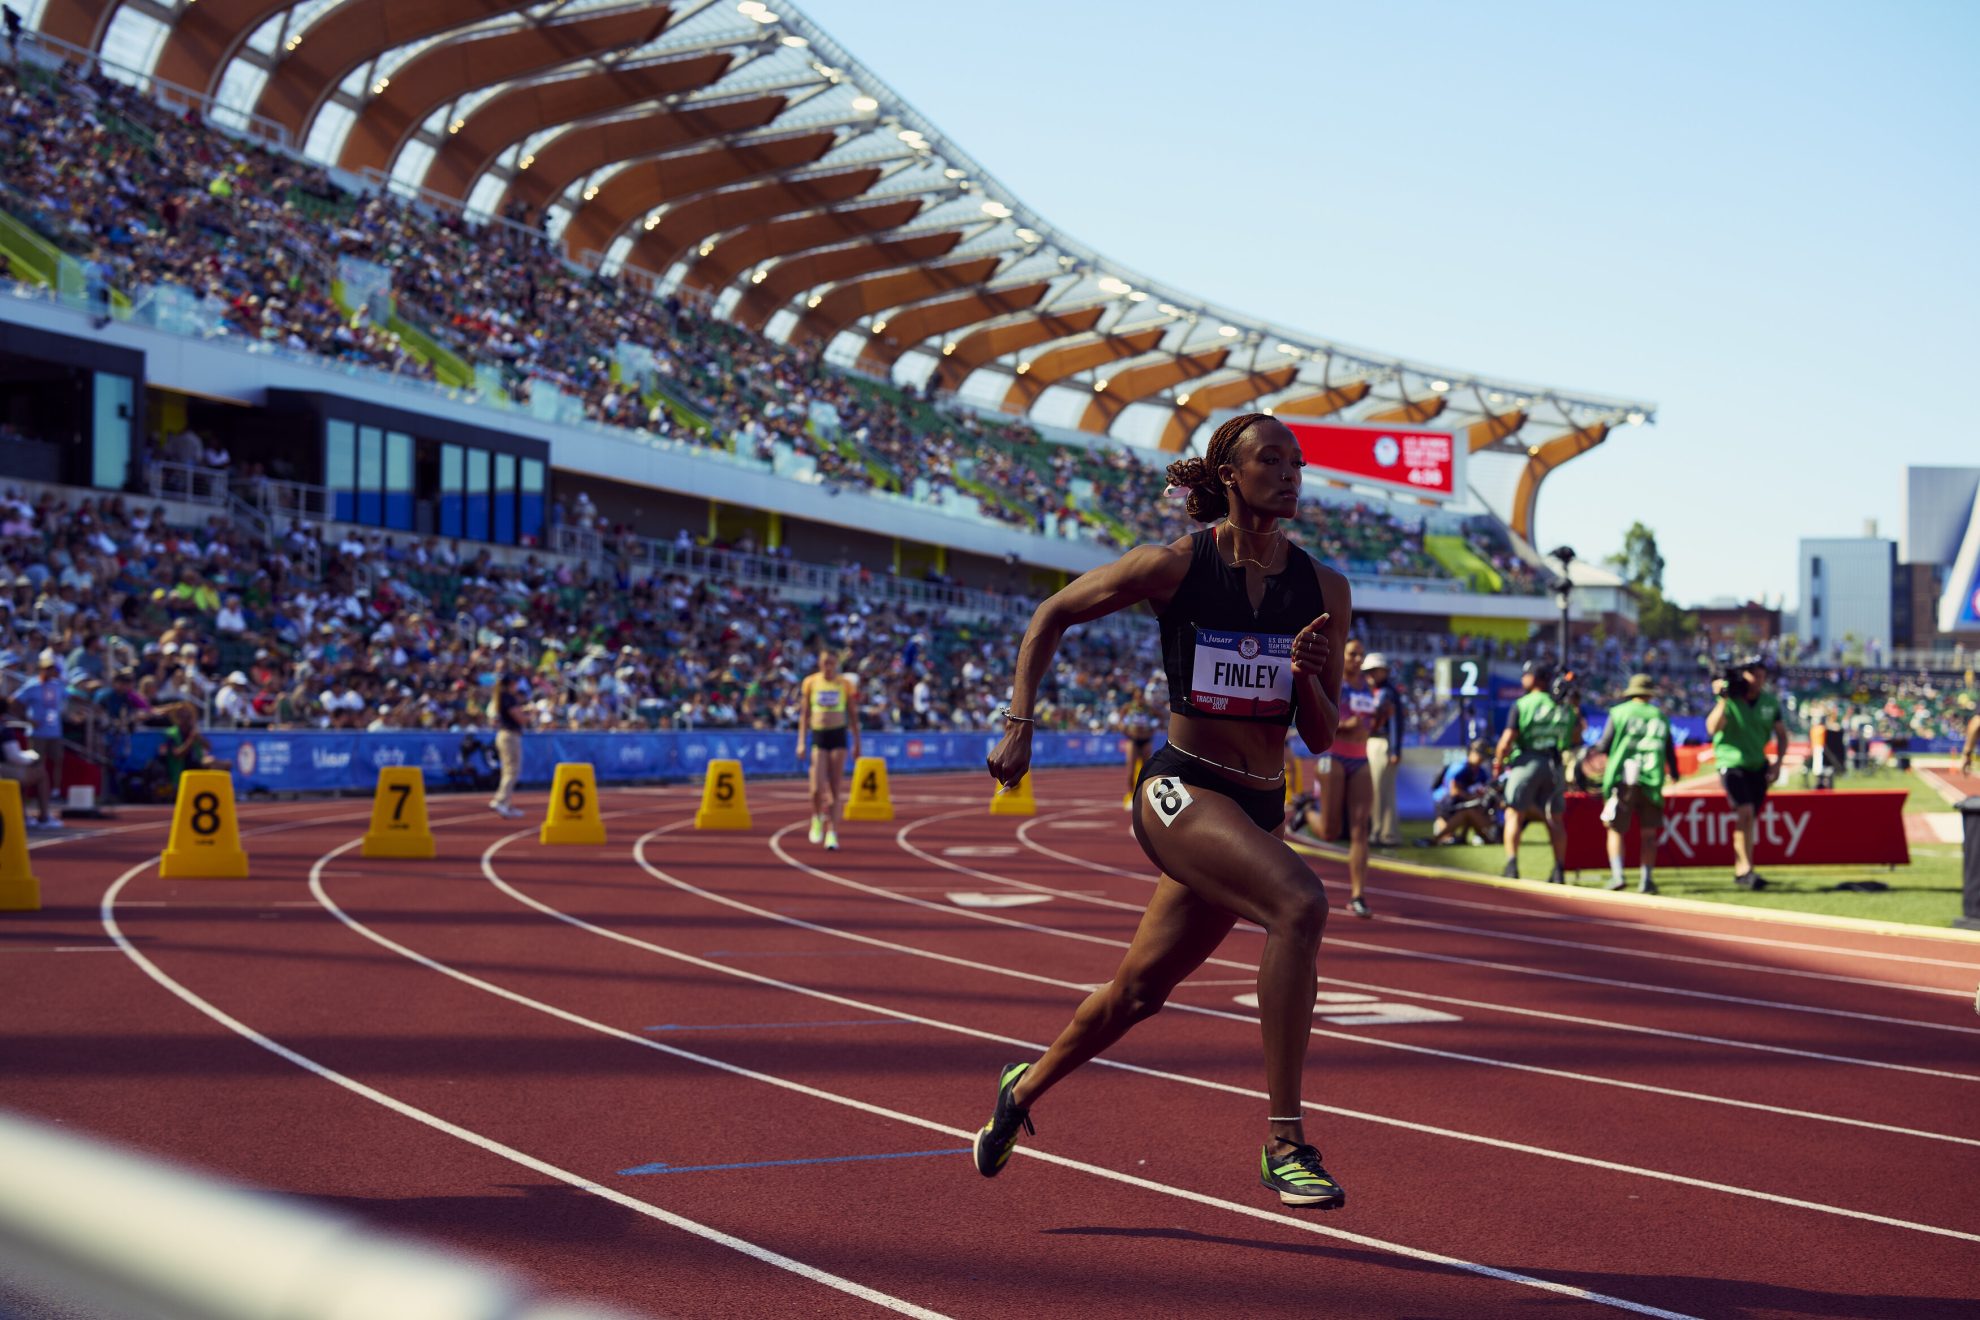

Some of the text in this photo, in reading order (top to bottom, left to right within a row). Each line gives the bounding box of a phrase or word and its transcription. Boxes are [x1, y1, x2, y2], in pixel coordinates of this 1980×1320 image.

[1214, 662, 1279, 688] FINLEY
[1460, 661, 1479, 695] 2
[1196, 695, 1229, 704] TRACKTOWN
[1212, 702, 1226, 710] 2024
[563, 780, 586, 812] 6
[715, 772, 734, 801] 5
[861, 771, 877, 795] 4
[191, 791, 220, 835] 8
[388, 784, 411, 820] 7
